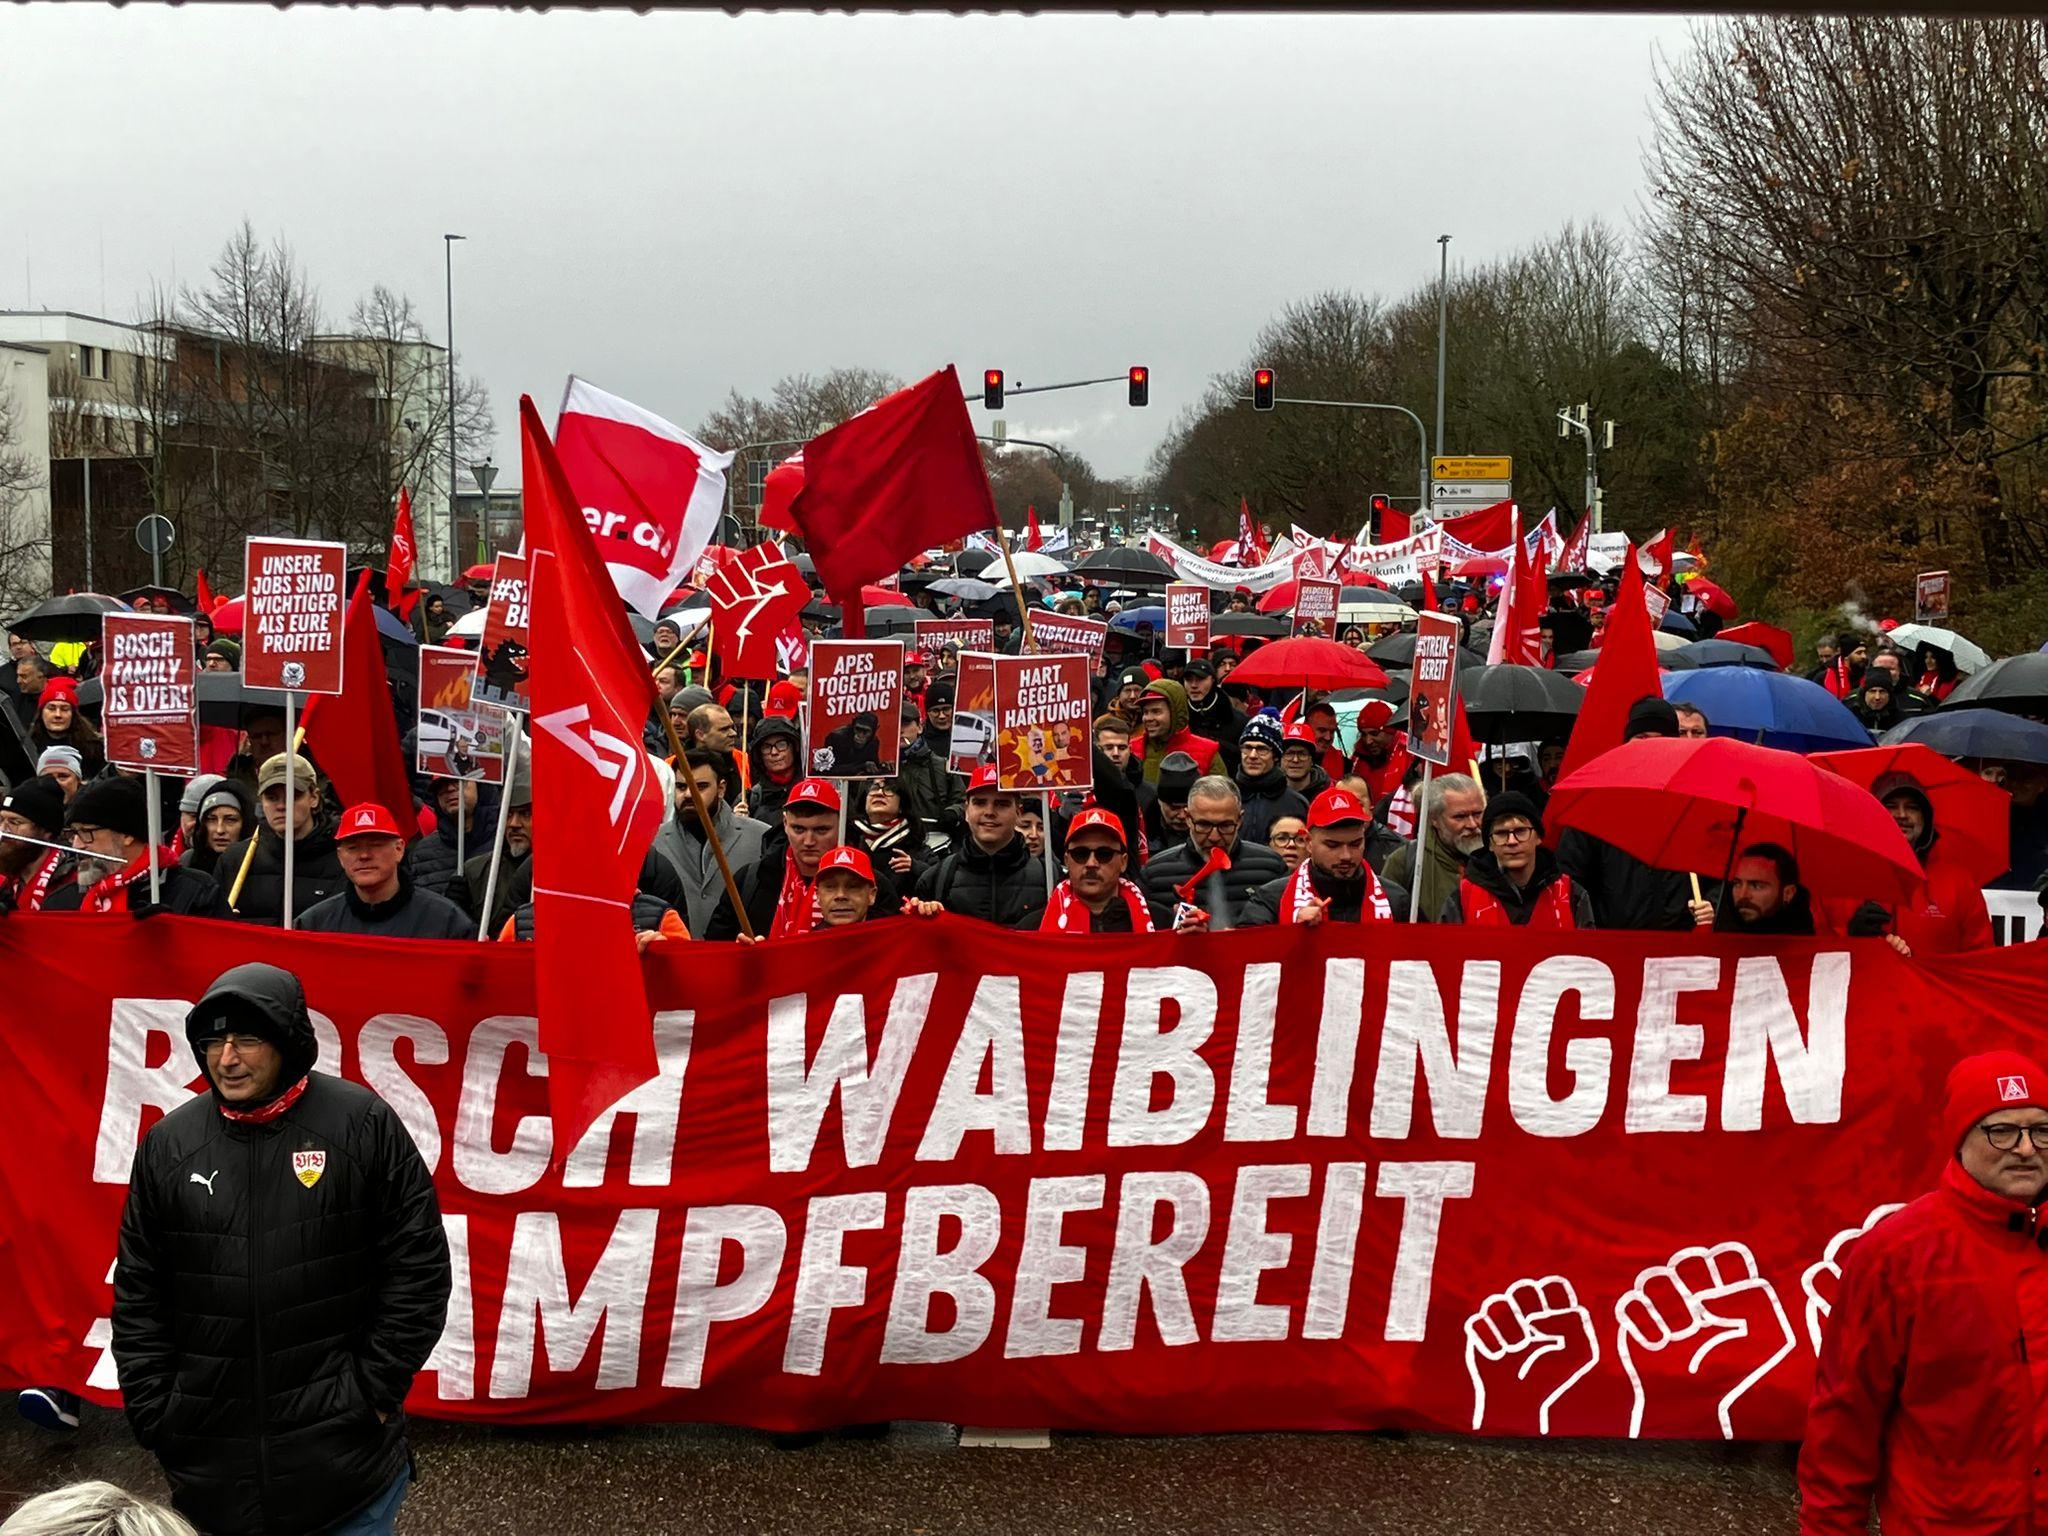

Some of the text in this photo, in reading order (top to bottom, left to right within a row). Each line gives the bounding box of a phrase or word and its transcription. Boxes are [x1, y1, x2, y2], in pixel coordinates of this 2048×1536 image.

[262, 554, 322, 575] UNSERE
[252, 573, 335, 596] JOBS SIND
[252, 593, 338, 615] WICHTIGER
[1170, 603, 1208, 614] OHNE
[1171, 592, 1203, 606] NICHT
[257, 613, 329, 634] ALS EURE
[1171, 611, 1209, 626] KAMPF!
[113, 631, 175, 659] BOSCH
[262, 632, 331, 654] PROFITE!
[111, 658, 182, 685] FAMILY
[833, 652, 875, 676] APES
[1419, 658, 1448, 681] BEREIT
[817, 670, 898, 698] TOGETHER
[1019, 664, 1062, 689] HART
[109, 685, 189, 711] IS OVER!
[826, 690, 891, 717] STRONG
[1017, 682, 1069, 706] GEGEN
[1005, 699, 1087, 728] HARTUNG!
[766, 951, 1851, 1173] WAIBLINGEN
